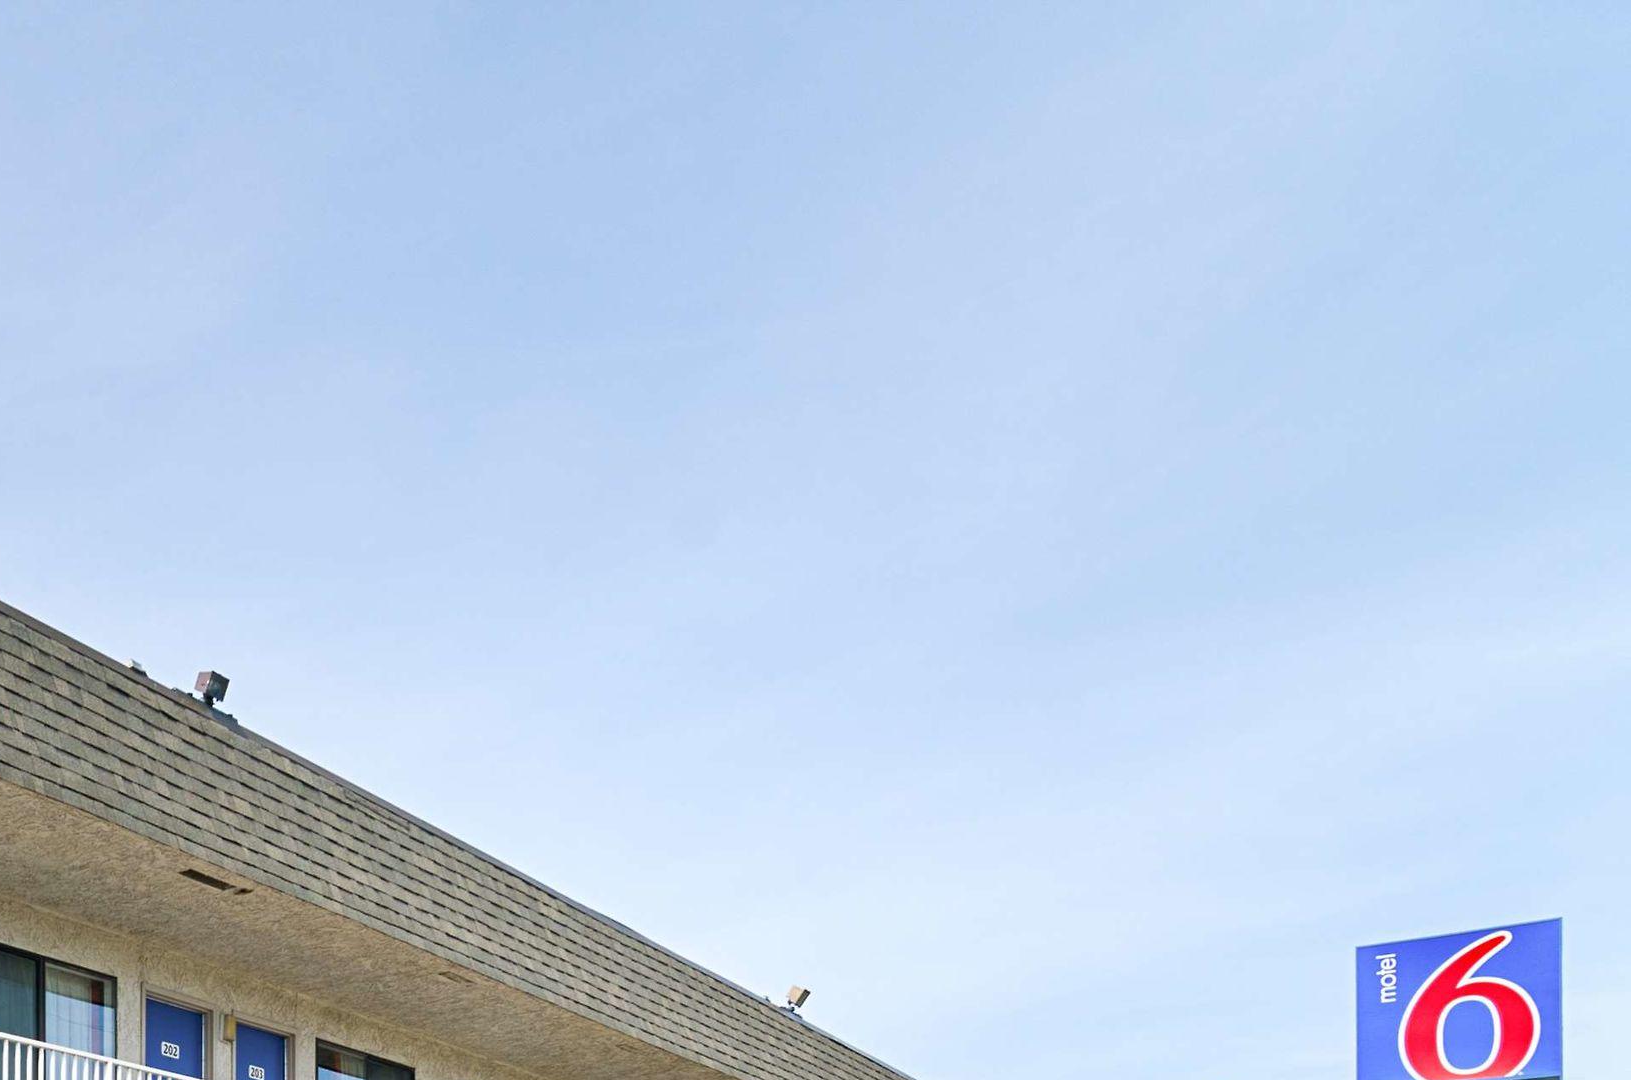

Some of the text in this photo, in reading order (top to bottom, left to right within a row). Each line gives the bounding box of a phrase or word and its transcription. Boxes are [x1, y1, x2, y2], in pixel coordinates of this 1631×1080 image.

[1375, 953, 1397, 1003] motel
[163, 1043, 178, 1057] 202
[250, 1066, 263, 1079] 203
